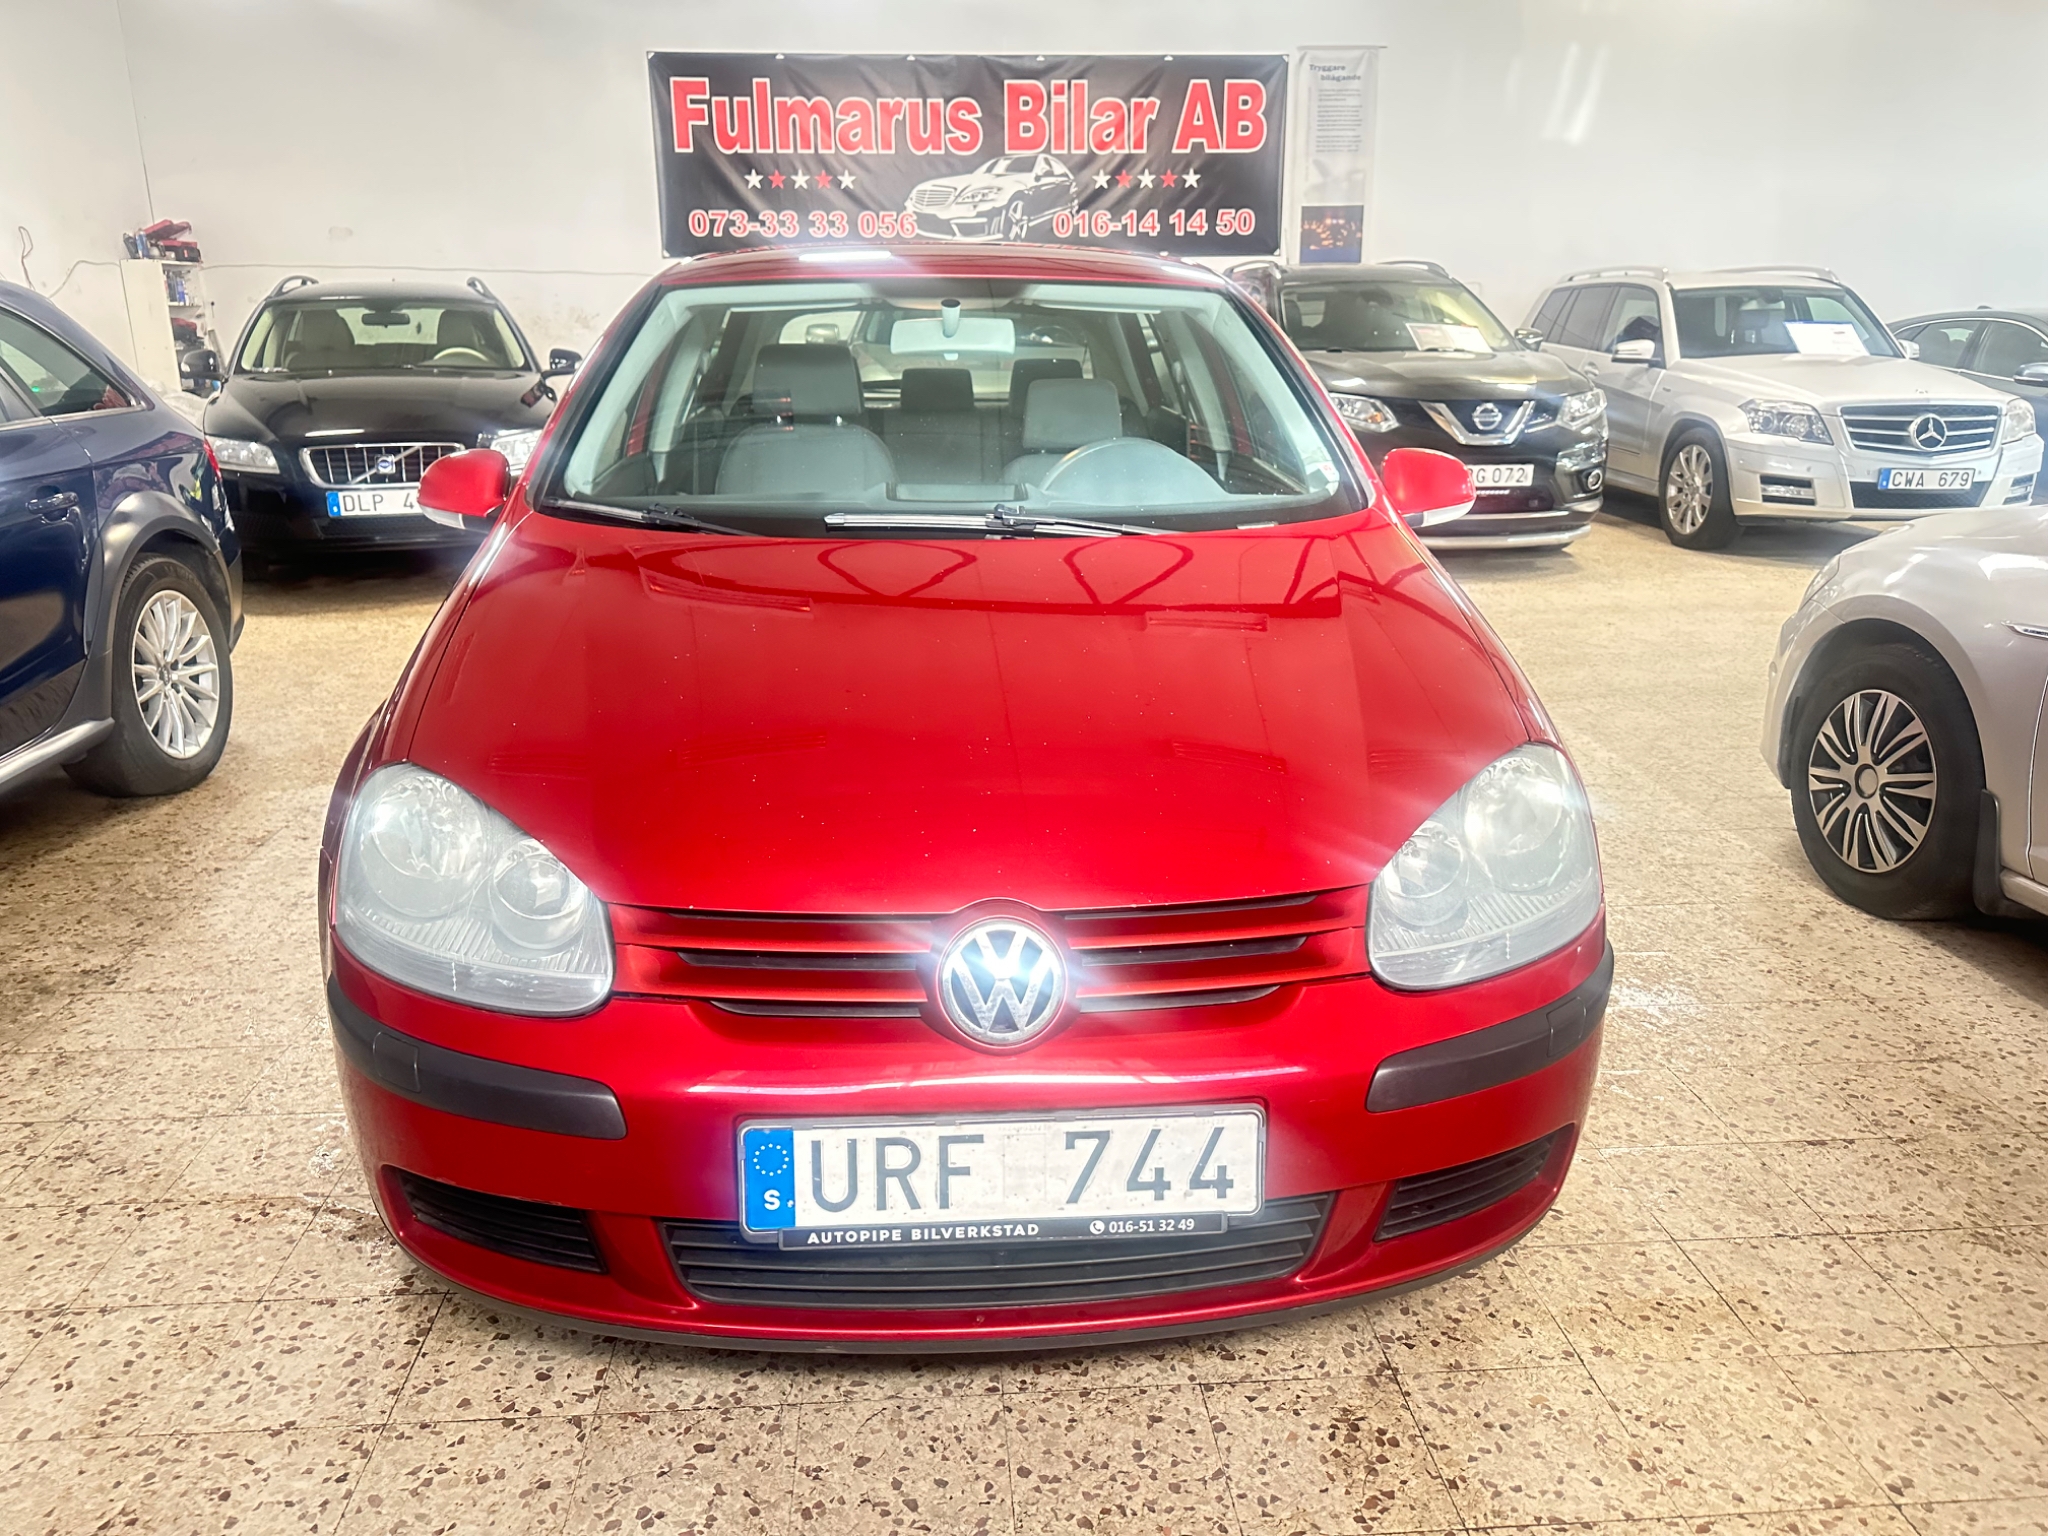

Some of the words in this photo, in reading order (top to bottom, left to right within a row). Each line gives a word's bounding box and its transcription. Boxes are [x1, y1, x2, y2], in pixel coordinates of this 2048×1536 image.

[670, 77, 983, 155] Fulmarus
[1004, 79, 1160, 155] Bilar
[1171, 79, 1267, 153] AB
[688, 210, 799, 238] 073-33
[808, 210, 849, 238] 33
[857, 211, 918, 239] 056
[1052, 209, 1160, 238] 016-14
[1169, 209, 1208, 236] 14
[1215, 208, 1255, 235] 50
[1492, 468, 1525, 483] 072
[1892, 472, 1924, 487] CWA
[1938, 472, 1970, 487] 679
[342, 494, 384, 512] DLP
[811, 1134, 984, 1213] URF
[1065, 1127, 1234, 1204] 744
[763, 1189, 781, 1210] S
[807, 1229, 902, 1244] AUTOPIPE
[911, 1224, 1039, 1240] BILVERKSTAD
[1108, 1220, 1155, 1233] 016-51
[1159, 1219, 1175, 1231] 32
[1178, 1218, 1195, 1231] 49
